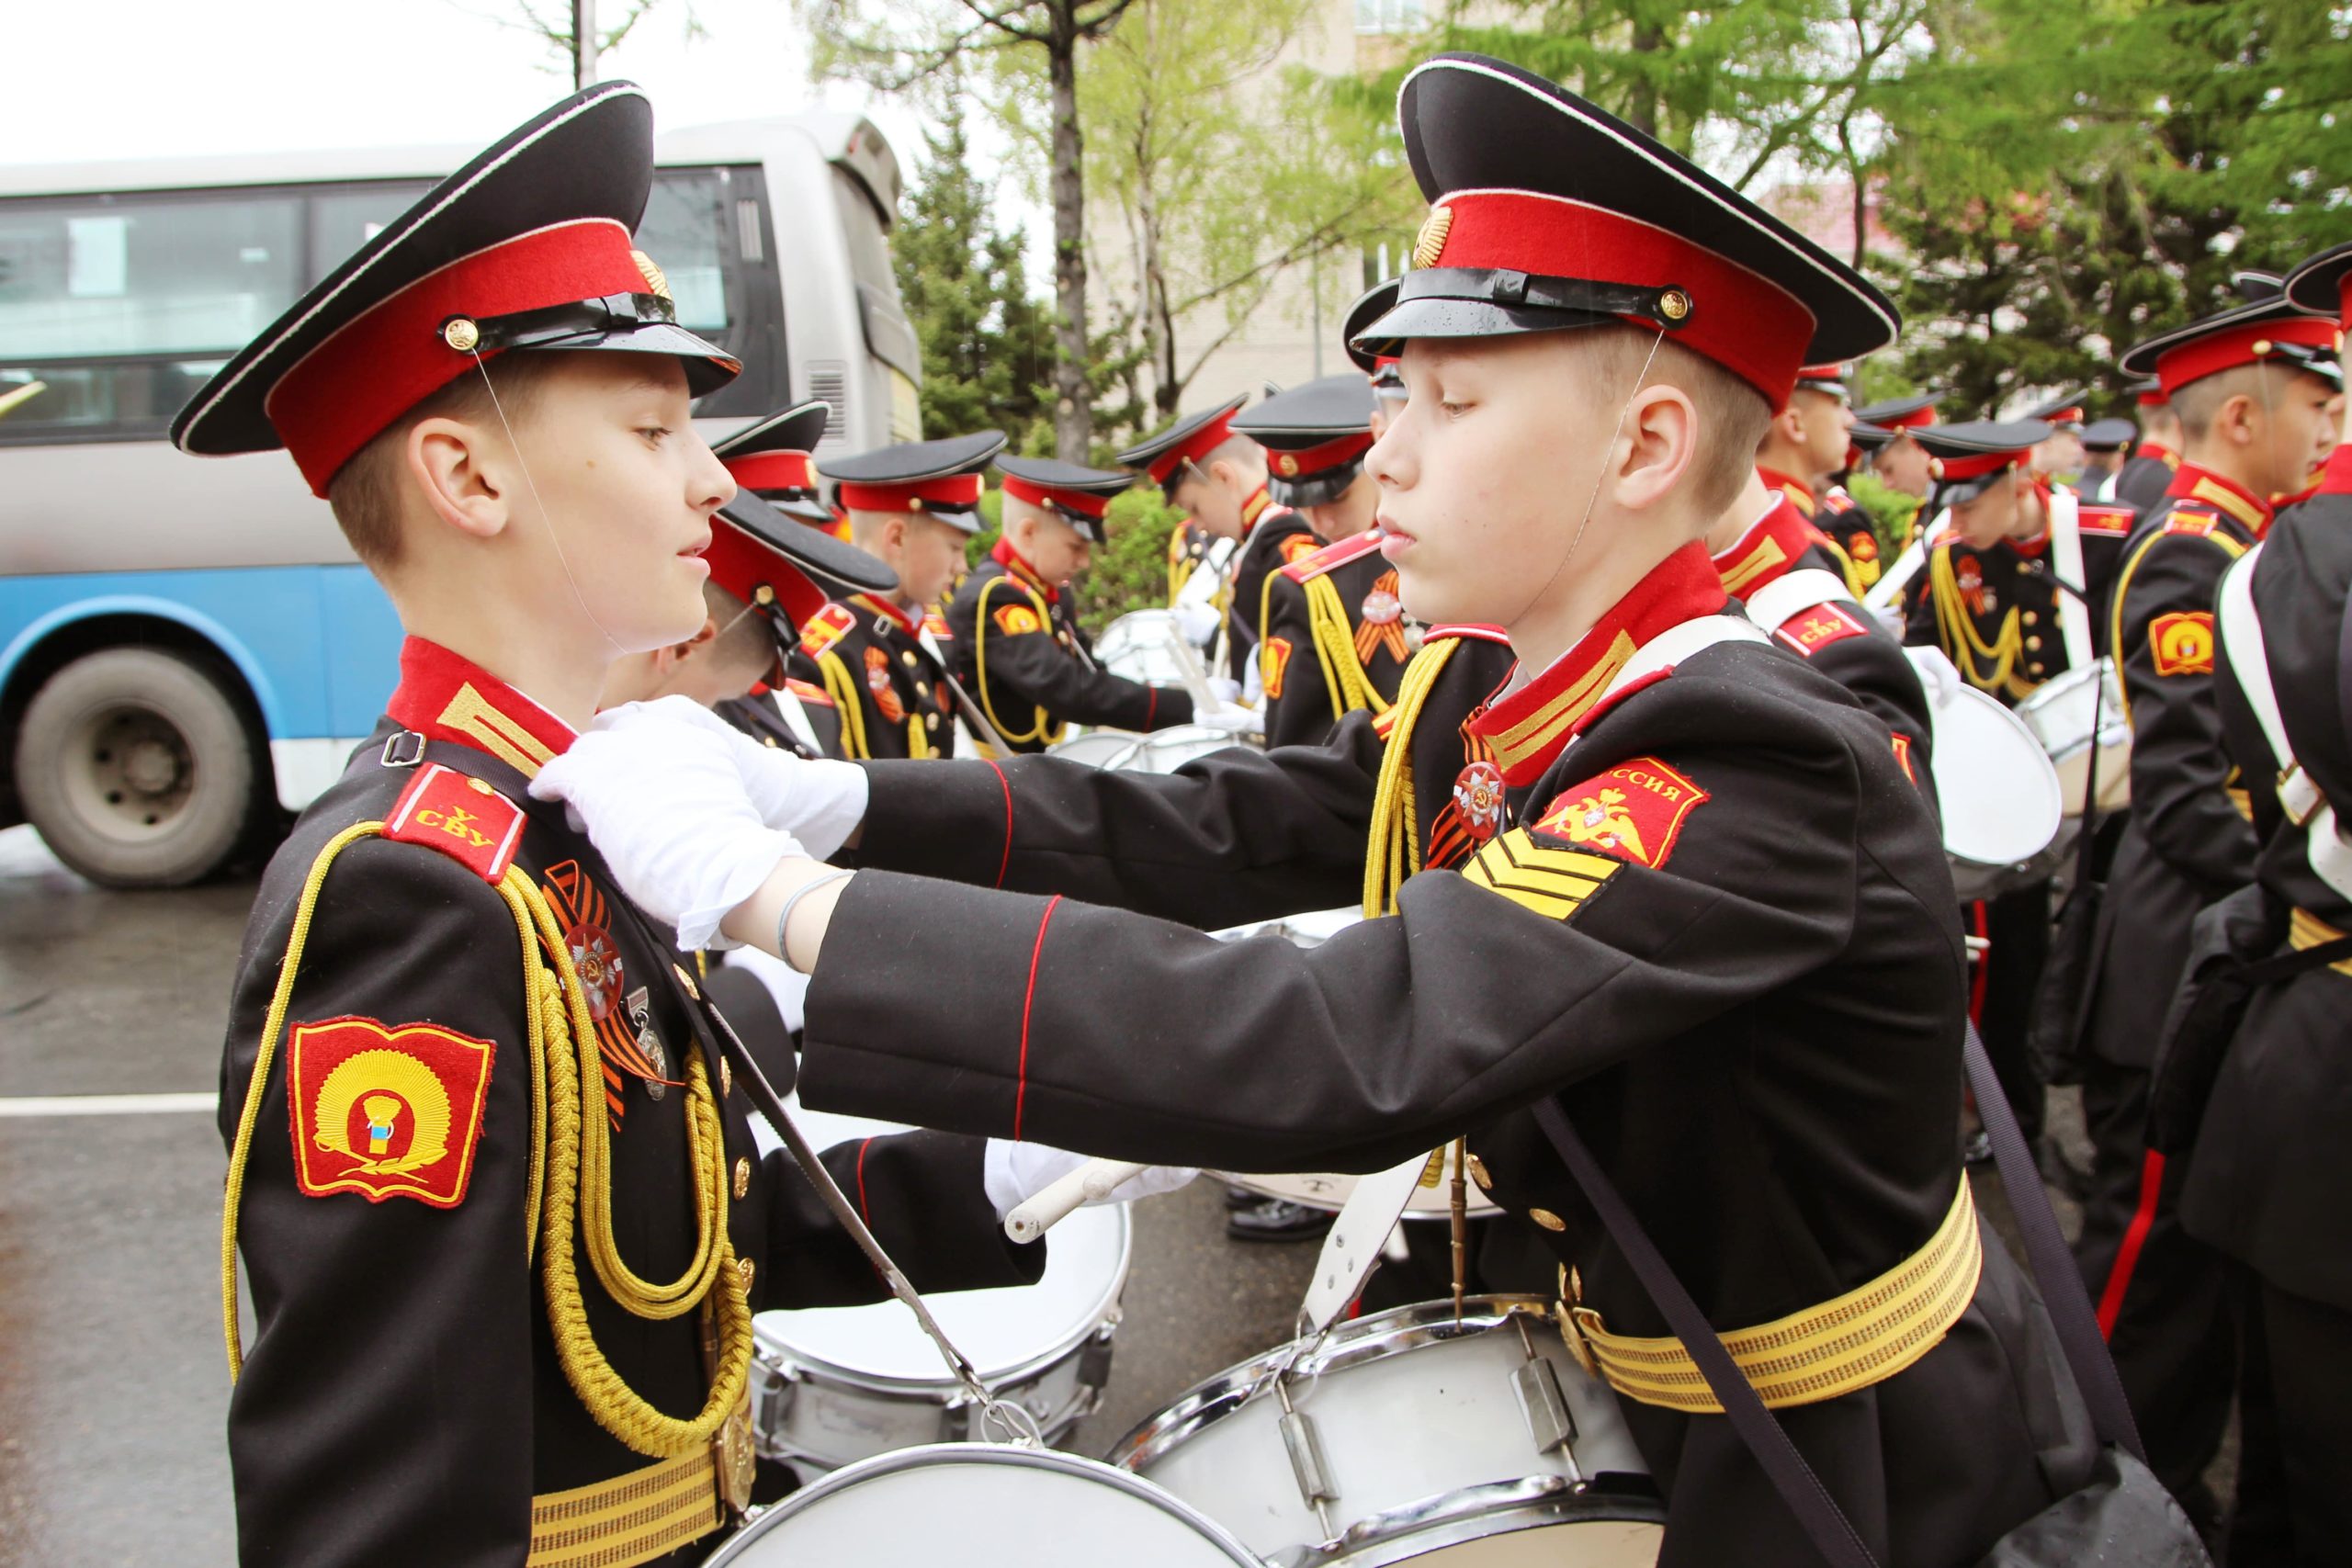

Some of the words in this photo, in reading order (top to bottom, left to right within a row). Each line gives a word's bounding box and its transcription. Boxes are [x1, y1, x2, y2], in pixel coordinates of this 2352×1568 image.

[1599, 768, 1682, 802] ССИЯ
[415, 809, 496, 847] СВУ
[452, 805, 479, 822] У
